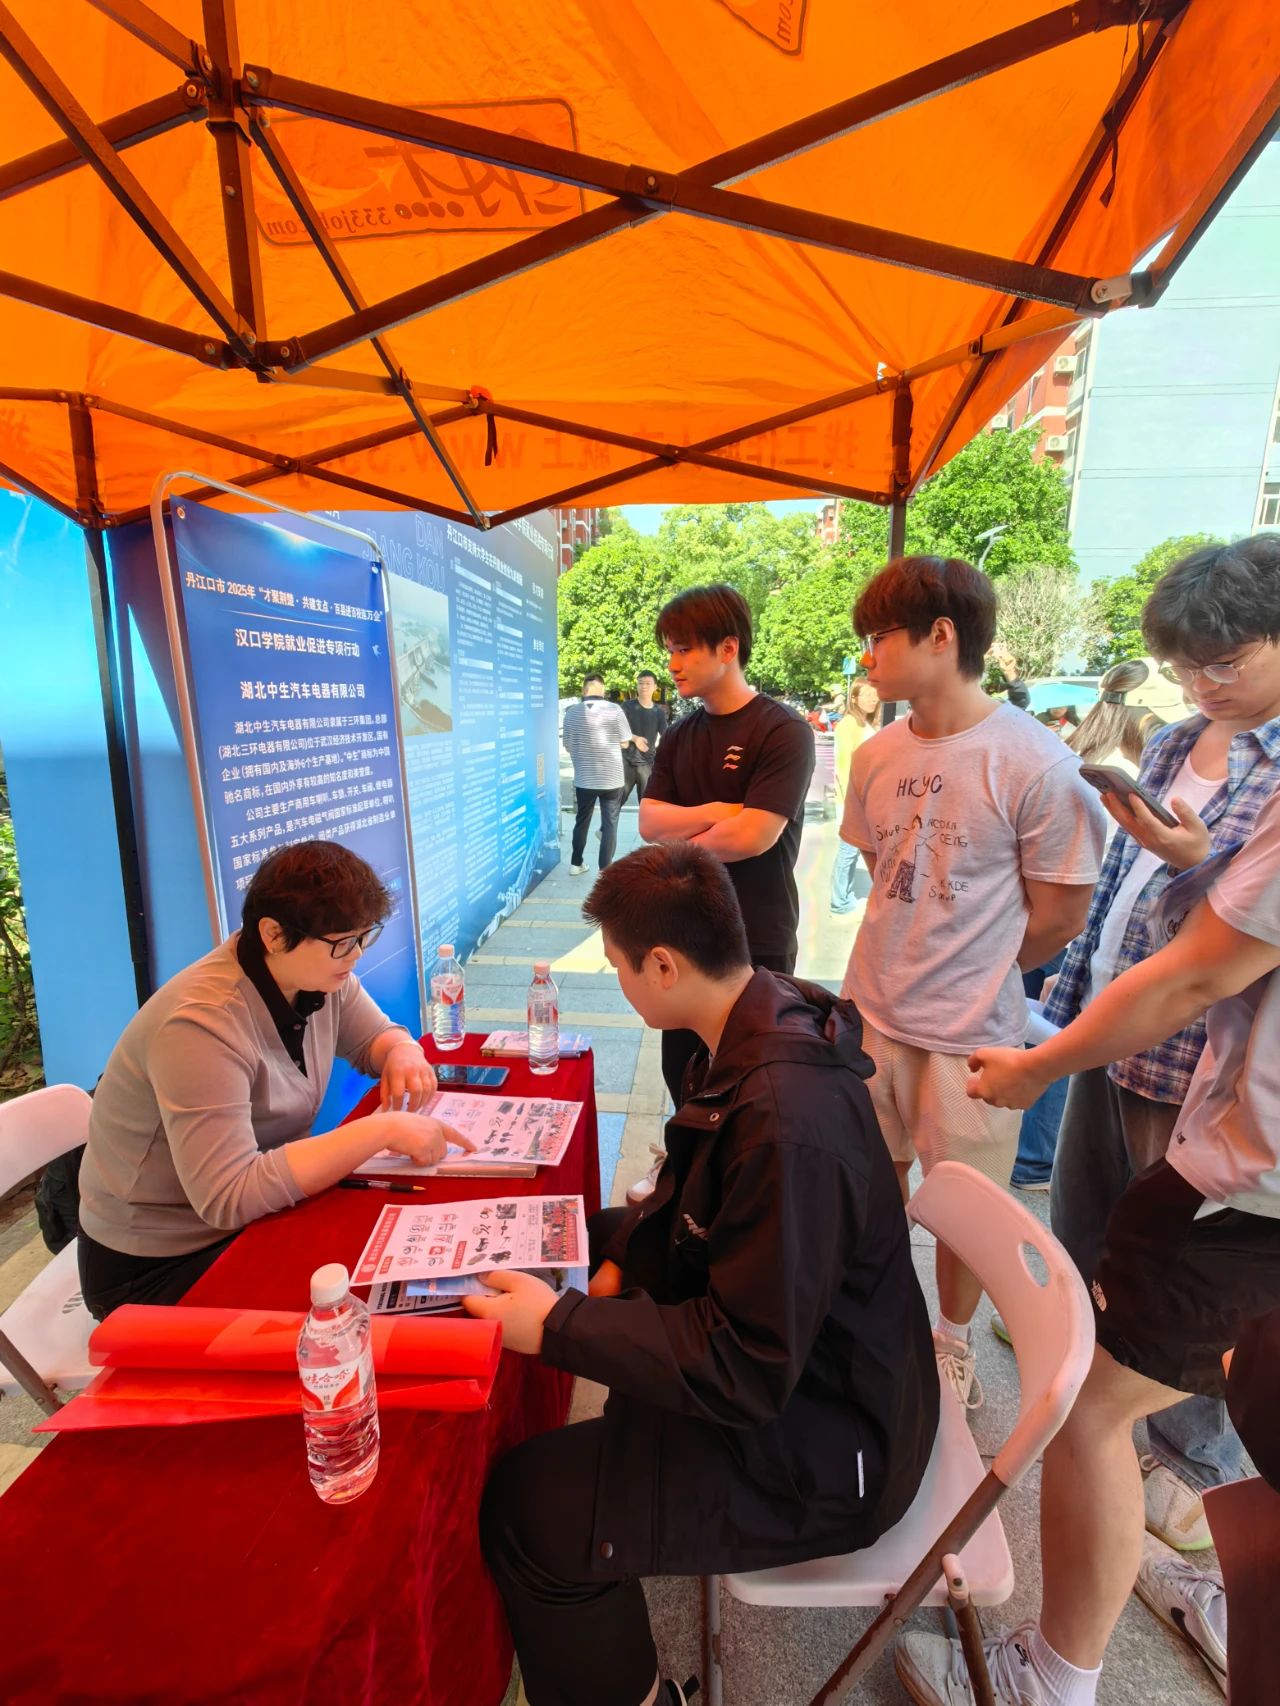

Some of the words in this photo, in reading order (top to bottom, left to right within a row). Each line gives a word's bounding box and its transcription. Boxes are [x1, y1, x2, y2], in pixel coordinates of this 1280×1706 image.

[185, 571, 226, 594] 丹江口市
[227, 581, 256, 600] 2025年
[235, 628, 361, 658] 汉口学院就业促进专项行动
[240, 680, 365, 700] 湖北中生汽车电器有限公司
